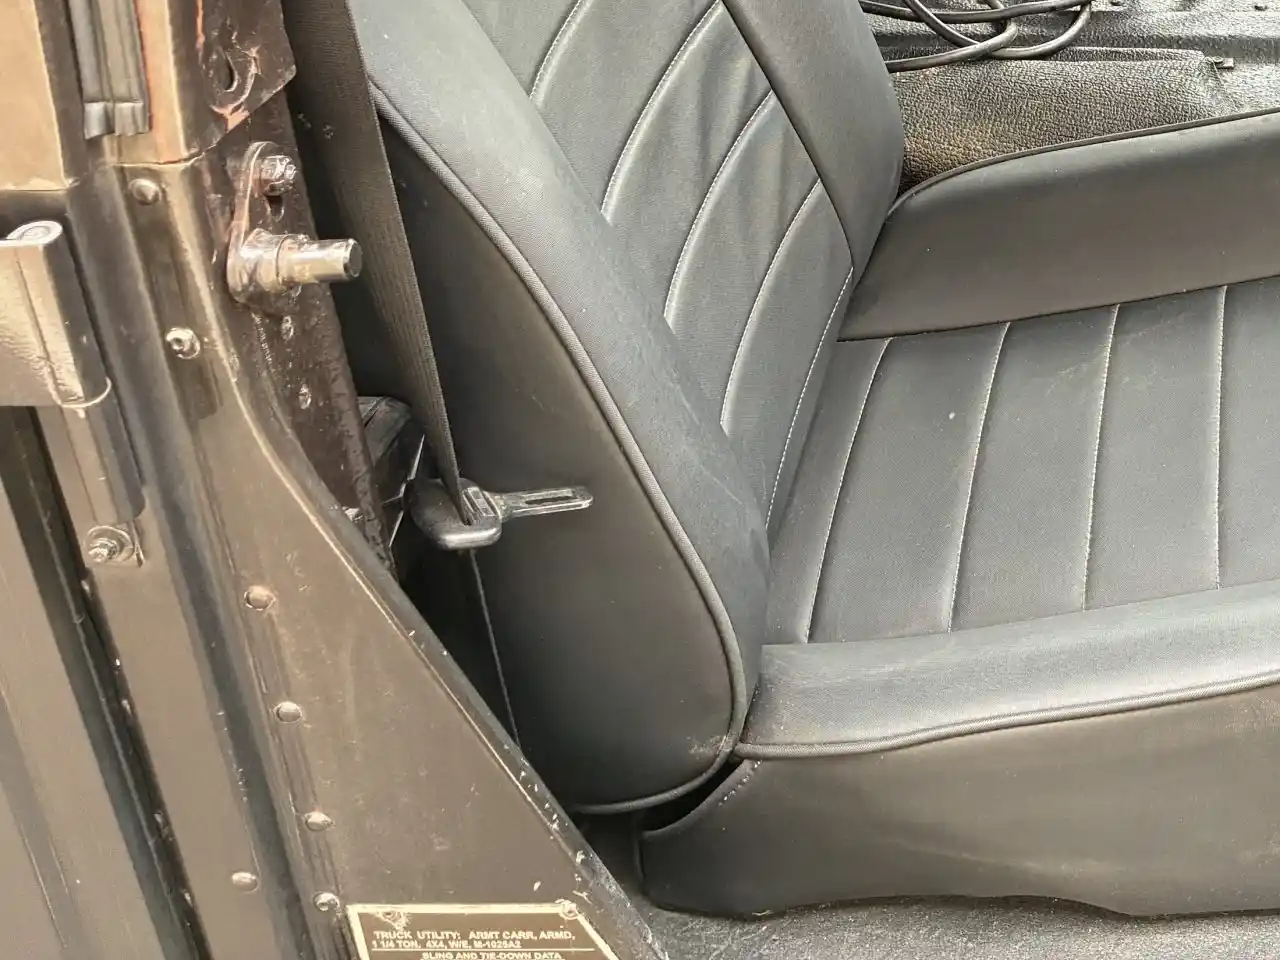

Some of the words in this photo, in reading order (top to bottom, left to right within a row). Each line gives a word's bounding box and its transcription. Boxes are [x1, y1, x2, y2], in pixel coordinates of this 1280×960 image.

[373, 930, 413, 940] TRUCK
[416, 930, 461, 940] UTILITY:
[468, 930, 500, 940] ARMT
[372, 940, 378, 949] 1
[380, 940, 395, 949] 1/4
[421, 951, 454, 960] SLING
[455, 951, 478, 960] AND
[479, 951, 532, 960] TIE-DOWN
[533, 951, 564, 960] DATA
